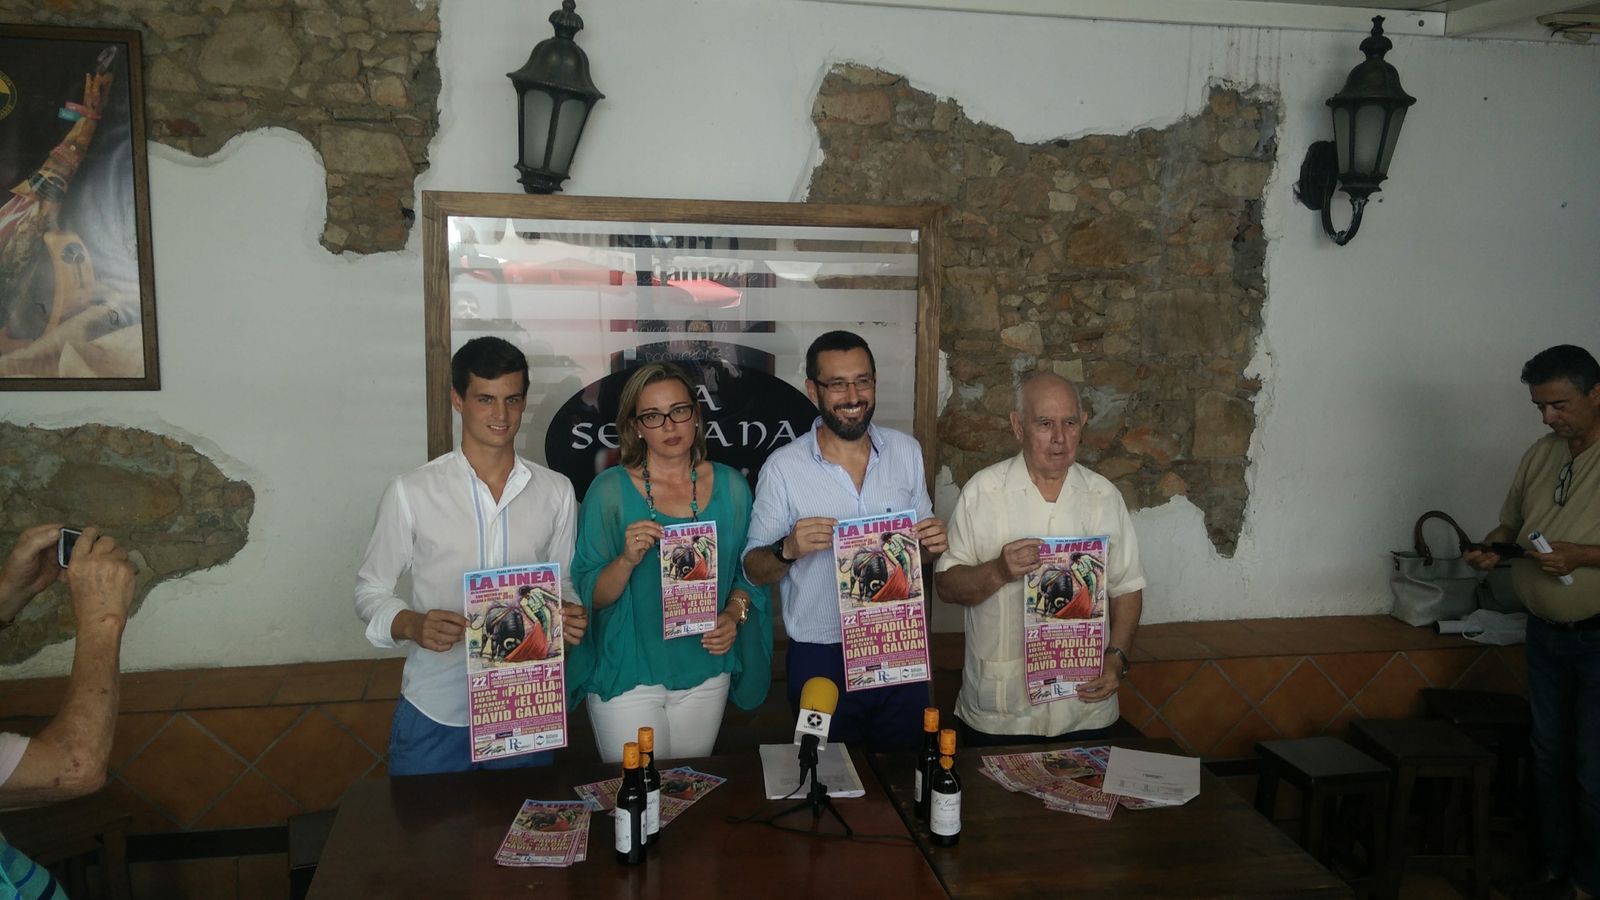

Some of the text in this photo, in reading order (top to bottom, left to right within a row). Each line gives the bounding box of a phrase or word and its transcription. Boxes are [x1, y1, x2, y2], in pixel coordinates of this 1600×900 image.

[571, 420, 798, 450] SEANA
[665, 526, 714, 538] LA LINEA
[838, 525, 859, 537] LA
[864, 518, 913, 534] LINEA
[1038, 540, 1103, 554] A LINEA
[470, 570, 556, 591] LA LINEA
[844, 616, 856, 625] 22
[1028, 630, 1039, 639] 22
[1088, 626, 1095, 635] 7
[846, 639, 925, 659] DAVID GALVAN
[1028, 658, 1100, 672] DAVID GALVAN
[545, 667, 552, 680] 7
[473, 676, 487, 688] 22
[473, 702, 562, 726] DAVID GALVAN
